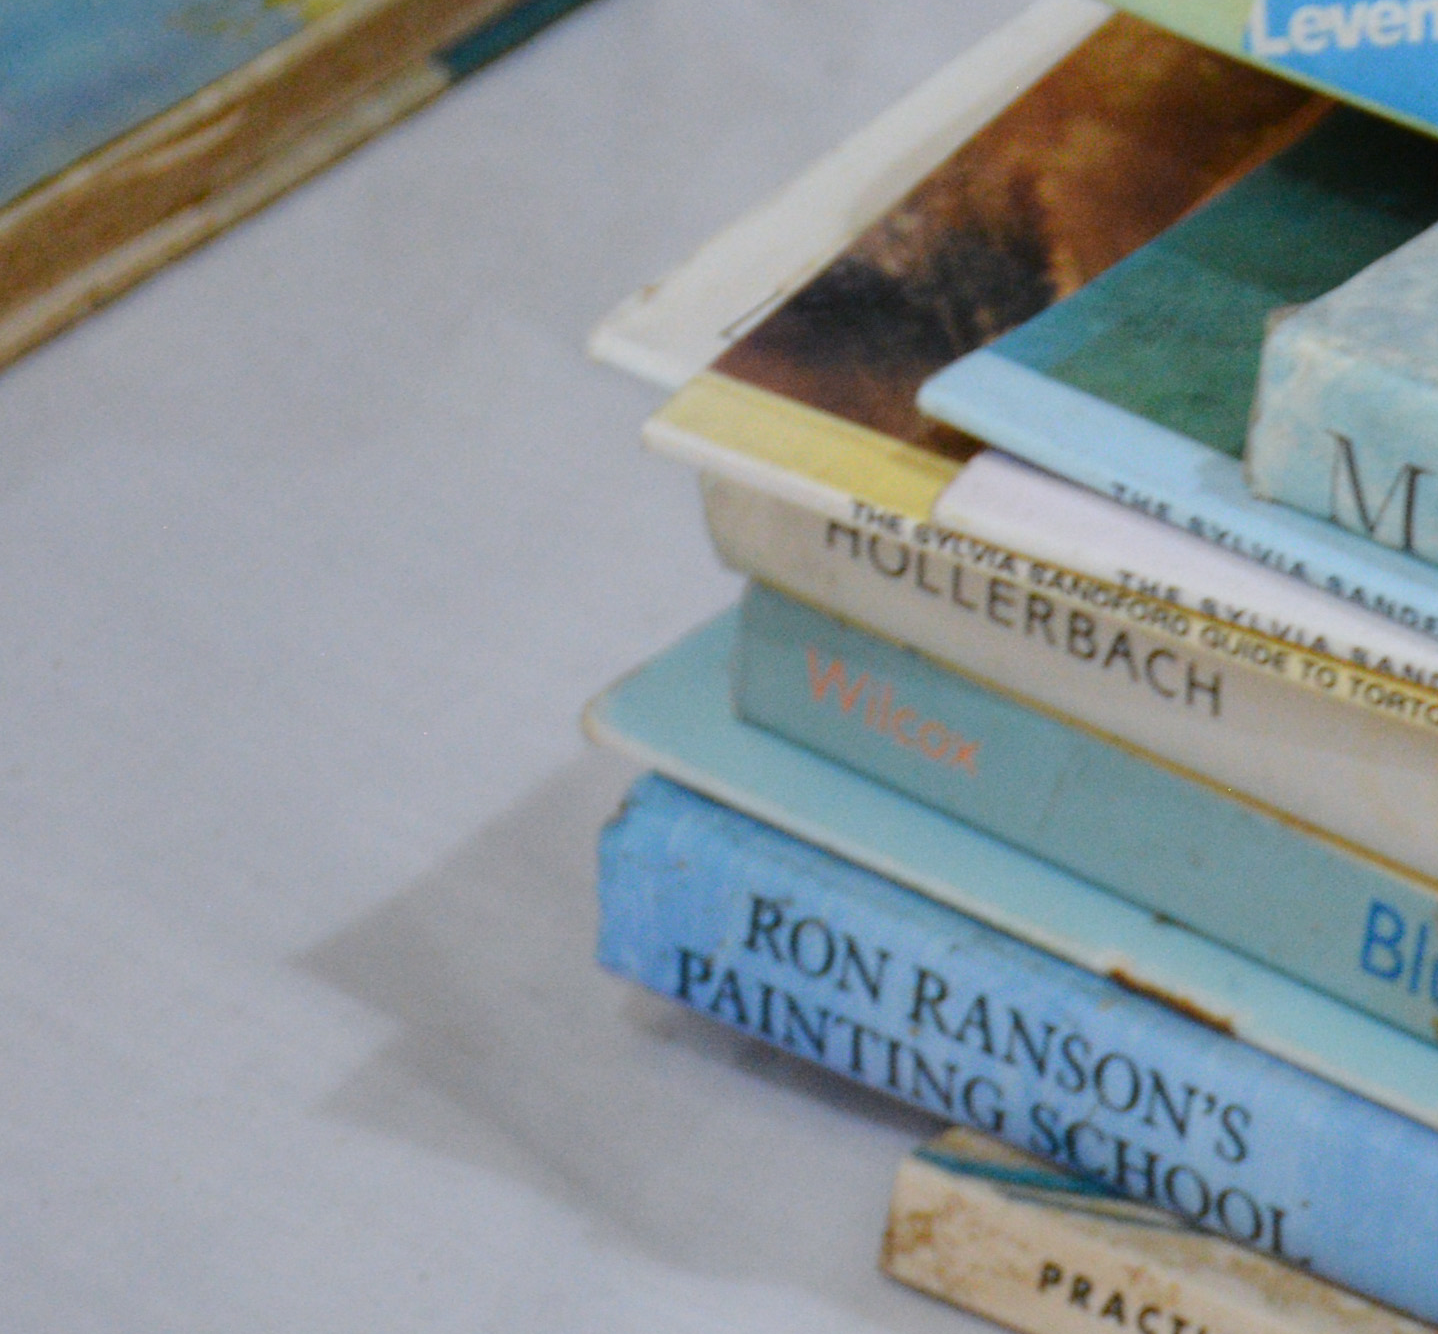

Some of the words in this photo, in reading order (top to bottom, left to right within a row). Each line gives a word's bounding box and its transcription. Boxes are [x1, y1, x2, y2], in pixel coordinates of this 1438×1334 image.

[826, 521, 1224, 718] HOLLERBACH
[852, 499, 903, 533] THE
[914, 525, 1018, 575] SYLVIA
[1030, 565, 1189, 638] SANDFORD
[1200, 626, 1289, 671] GUIDE
[1304, 660, 1338, 690] TO
[1112, 482, 1172, 522] THE
[1189, 516, 1307, 578] SYLVIA
[1119, 571, 1182, 602] THE
[1201, 598, 1330, 653] SYLVIA
[804, 646, 983, 774] Wilcox
[673, 949, 1004, 1135] PAINTING
[1028, 1101, 1316, 1271] SCHOOL
[743, 892, 892, 1005] RON
[909, 965, 1254, 1165] RANSON'S
